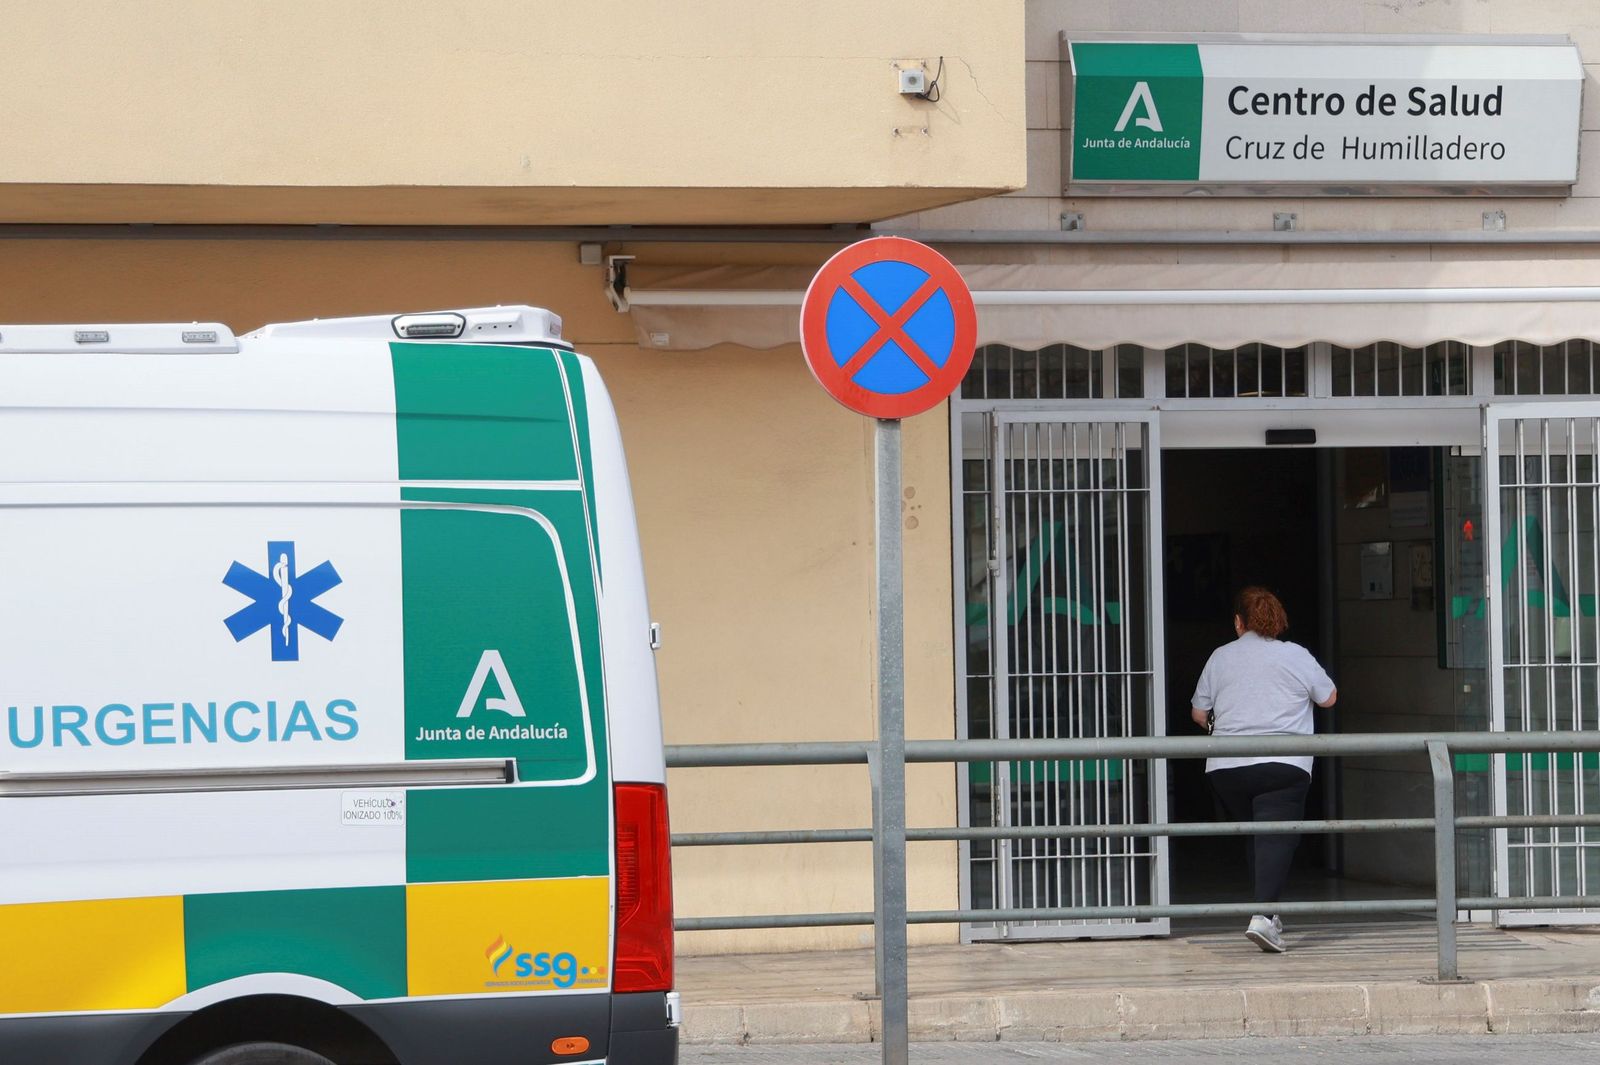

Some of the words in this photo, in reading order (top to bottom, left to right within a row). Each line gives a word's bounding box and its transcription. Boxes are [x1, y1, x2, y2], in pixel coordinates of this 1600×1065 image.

[1228, 85, 1345, 116] Centro
[1355, 84, 1397, 116] de
[1407, 84, 1503, 116] Salud
[1082, 138, 1115, 149] Junta
[1118, 137, 1132, 149] de
[1134, 136, 1191, 149] Andalucía
[1225, 134, 1285, 161] Cruz
[1293, 134, 1325, 161] de
[1341, 134, 1506, 161] Humilladero
[8, 699, 359, 748] URGENCIAS
[415, 727, 462, 742] Junta
[465, 725, 486, 740] de
[488, 722, 568, 740] Andalucía
[343, 810, 381, 820] IONIZADO
[383, 810, 403, 820] 100%
